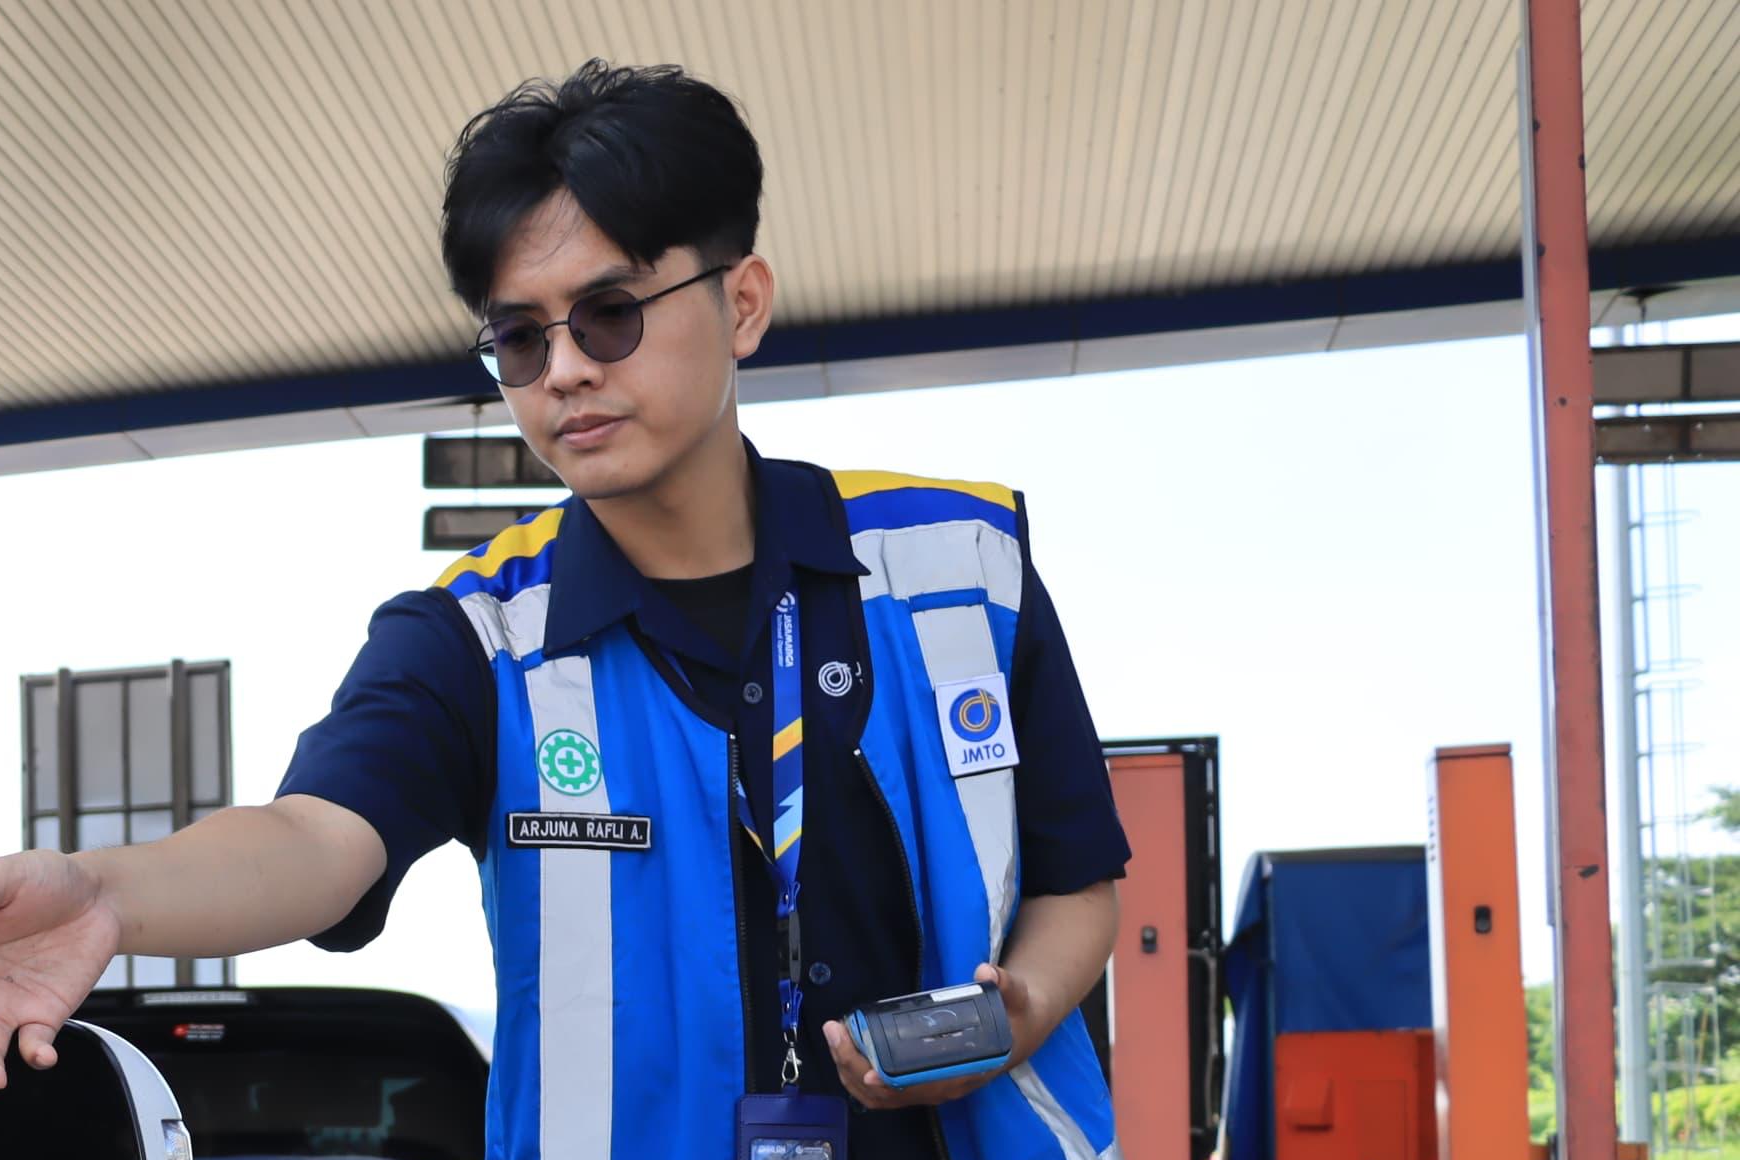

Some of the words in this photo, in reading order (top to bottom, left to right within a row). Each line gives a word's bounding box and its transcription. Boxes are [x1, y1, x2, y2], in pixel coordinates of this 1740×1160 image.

[961, 743, 1006, 765] JMTO
[519, 820, 579, 838] ARJUNA
[586, 821, 624, 840] RAFLI
[630, 823, 644, 841] A.
